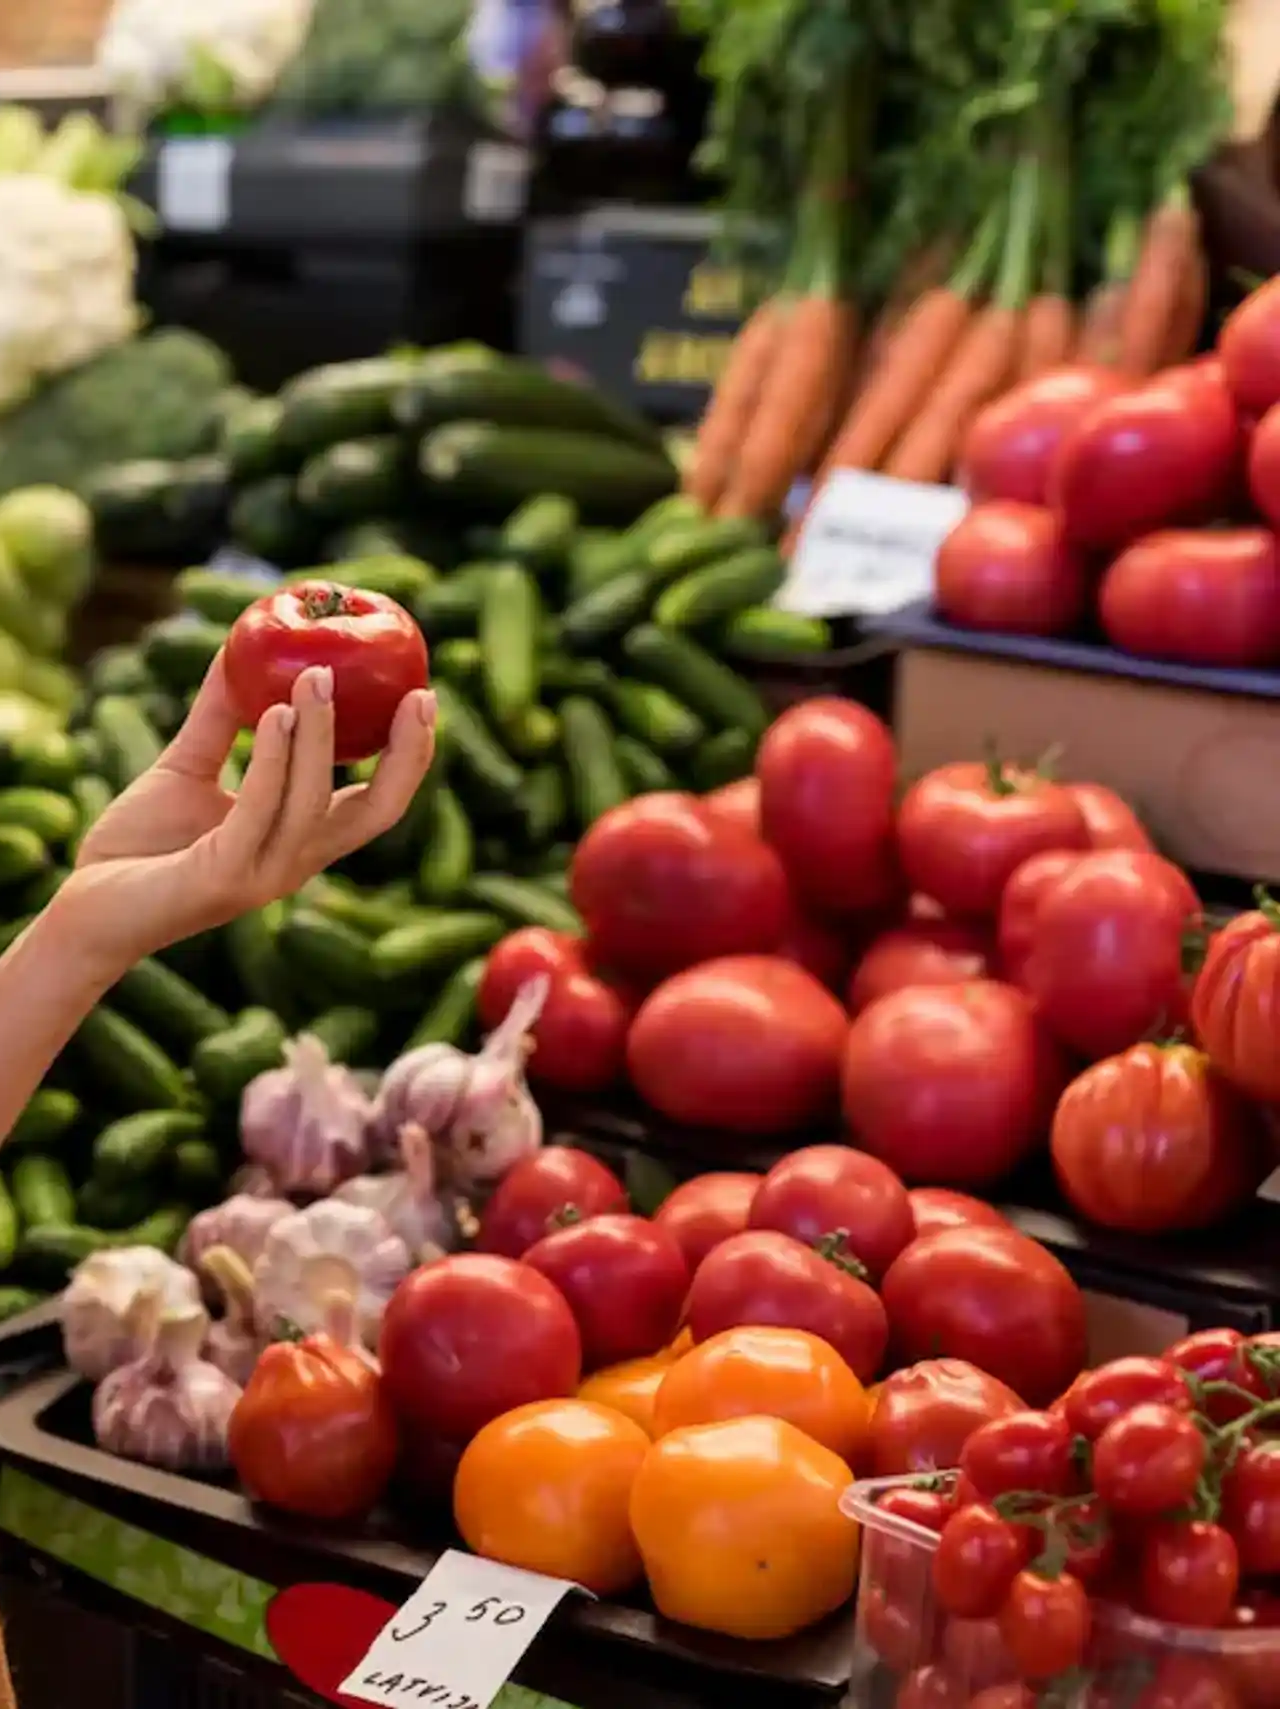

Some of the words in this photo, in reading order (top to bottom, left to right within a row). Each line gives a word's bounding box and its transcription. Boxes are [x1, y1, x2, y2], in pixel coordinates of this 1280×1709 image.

[391, 1601, 448, 1642] 3
[464, 1596, 526, 1626] 50
[362, 1671, 479, 1709] LATVIJ
